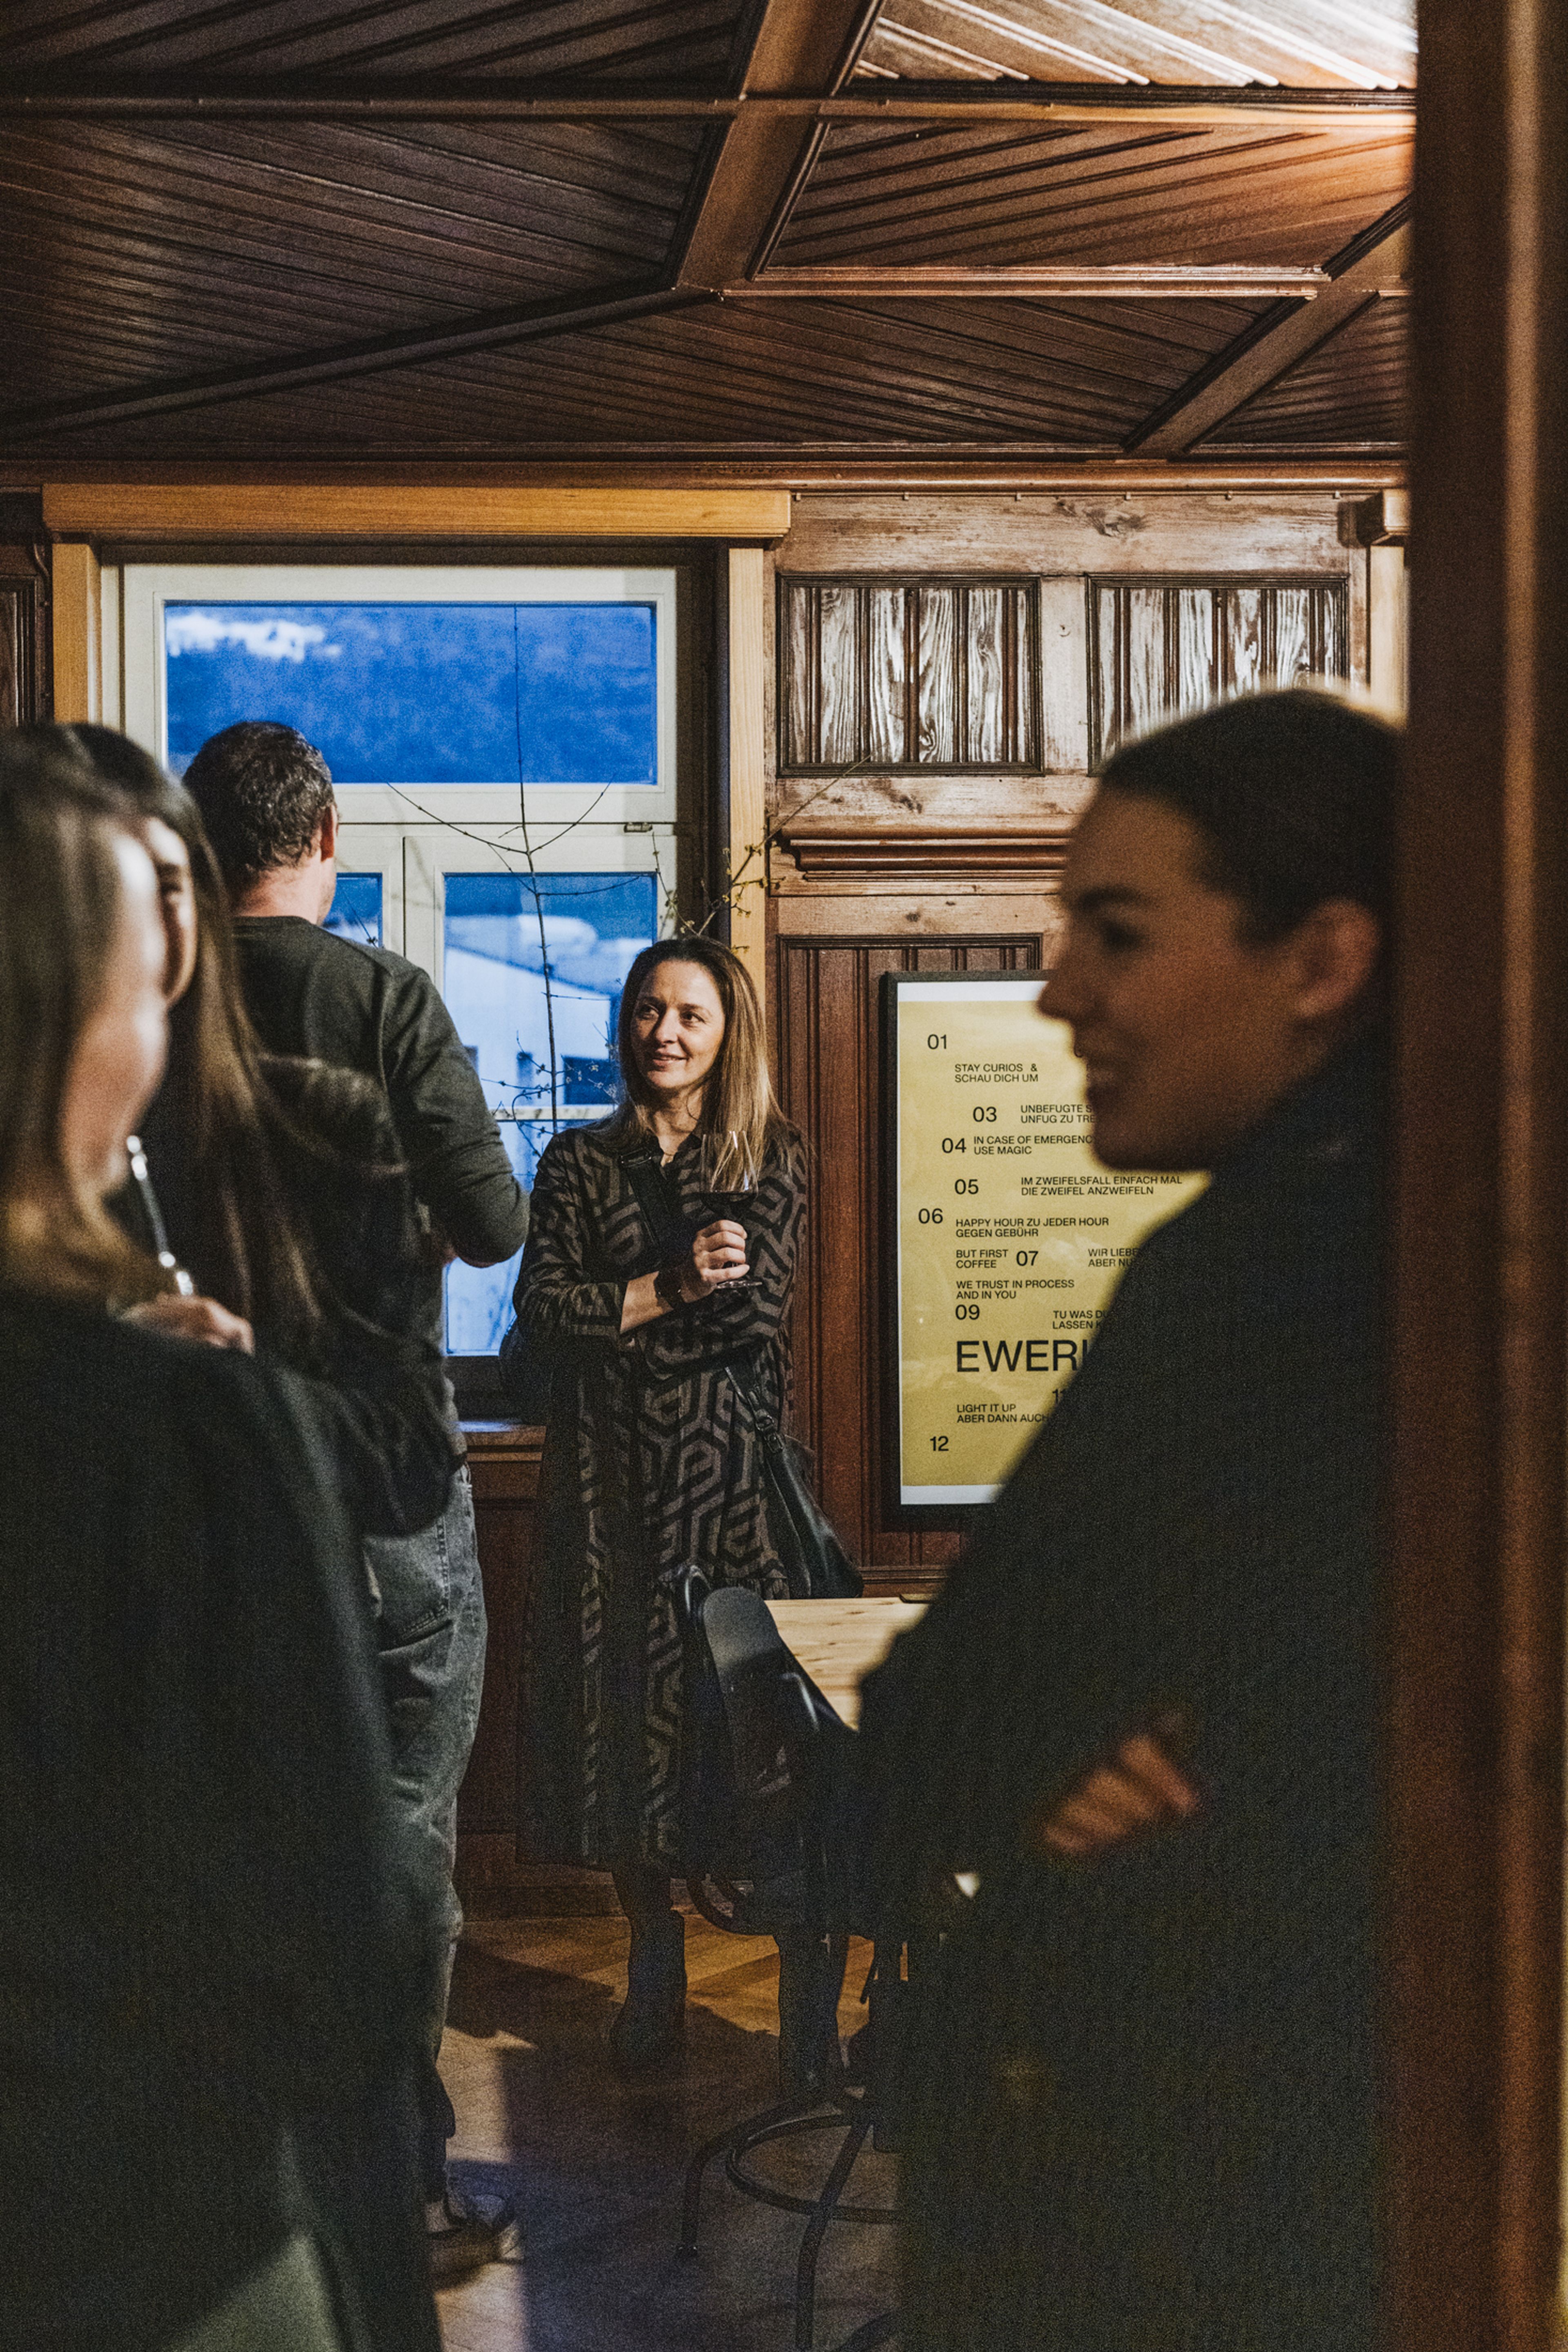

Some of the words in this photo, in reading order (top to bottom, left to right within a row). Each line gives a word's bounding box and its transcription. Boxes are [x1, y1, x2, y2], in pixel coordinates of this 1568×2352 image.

[927, 1033, 947, 1050] 01
[955, 1063, 980, 1073] STAY
[982, 1063, 1023, 1073] CURIOS
[1030, 1063, 1038, 1072] &
[955, 1074, 991, 1083] SCHAU
[993, 1074, 1019, 1083] DICH
[1022, 1074, 1038, 1083] UM
[1020, 1104, 1083, 1114] UNBEFUGTE
[972, 1106, 997, 1123] 03
[1020, 1114, 1058, 1124] UNFUG
[1060, 1114, 1074, 1124] ZU
[1076, 1114, 1096, 1124] TRE
[973, 1136, 984, 1145] IN
[986, 1135, 1015, 1145] CASE
[1017, 1135, 1031, 1145] OF
[1034, 1135, 1096, 1145] EMERGENC
[941, 1137, 967, 1154] 04
[973, 1146, 995, 1155] USE
[997, 1146, 1032, 1155] MAGIC
[1021, 1177, 1033, 1186] IM
[1035, 1176, 1111, 1186] ZWEIFELSFALL
[1113, 1176, 1158, 1185] EINFACH
[1160, 1175, 1183, 1184] MAL
[954, 1178, 979, 1195] 05
[1021, 1186, 1038, 1196] DIE
[1040, 1186, 1085, 1196] ZWEIFEL
[1087, 1186, 1154, 1195] ANZWEIFELN
[918, 1208, 944, 1224] 06
[956, 1218, 991, 1227] HAPPY
[993, 1218, 1024, 1227] HOUR
[1026, 1218, 1041, 1227] ZU
[1042, 1217, 1076, 1227] JEDER
[1078, 1217, 1109, 1226] HOUR
[956, 1228, 993, 1238] GEGEN
[994, 1226, 1039, 1237] GEBÜHR
[956, 1249, 977, 1259] BUT
[979, 1249, 1009, 1258] FIRST
[1087, 1248, 1108, 1257] WIR
[1110, 1248, 1139, 1257] LIEBE
[1016, 1250, 1039, 1267] 07
[1088, 1258, 1116, 1267] ABER
[956, 1259, 997, 1269] COFFEE
[956, 1280, 973, 1289] WE
[975, 1280, 1010, 1289] TRUST
[1012, 1280, 1023, 1289] IN
[1025, 1279, 1075, 1289] PROCESS
[956, 1290, 980, 1300] AND
[981, 1290, 992, 1300] IN
[994, 1290, 1017, 1300] YOU
[955, 1304, 980, 1320] 09
[1053, 1310, 1067, 1320] TU
[1069, 1310, 1093, 1319] WAS
[1052, 1320, 1093, 1330] LASSEN
[956, 1404, 988, 1413] LIGHT
[990, 1403, 1000, 1413] IT
[1002, 1403, 1016, 1413] UP
[956, 1414, 985, 1423] ABER
[987, 1413, 1017, 1423] DANN
[929, 1435, 949, 1452] 12
